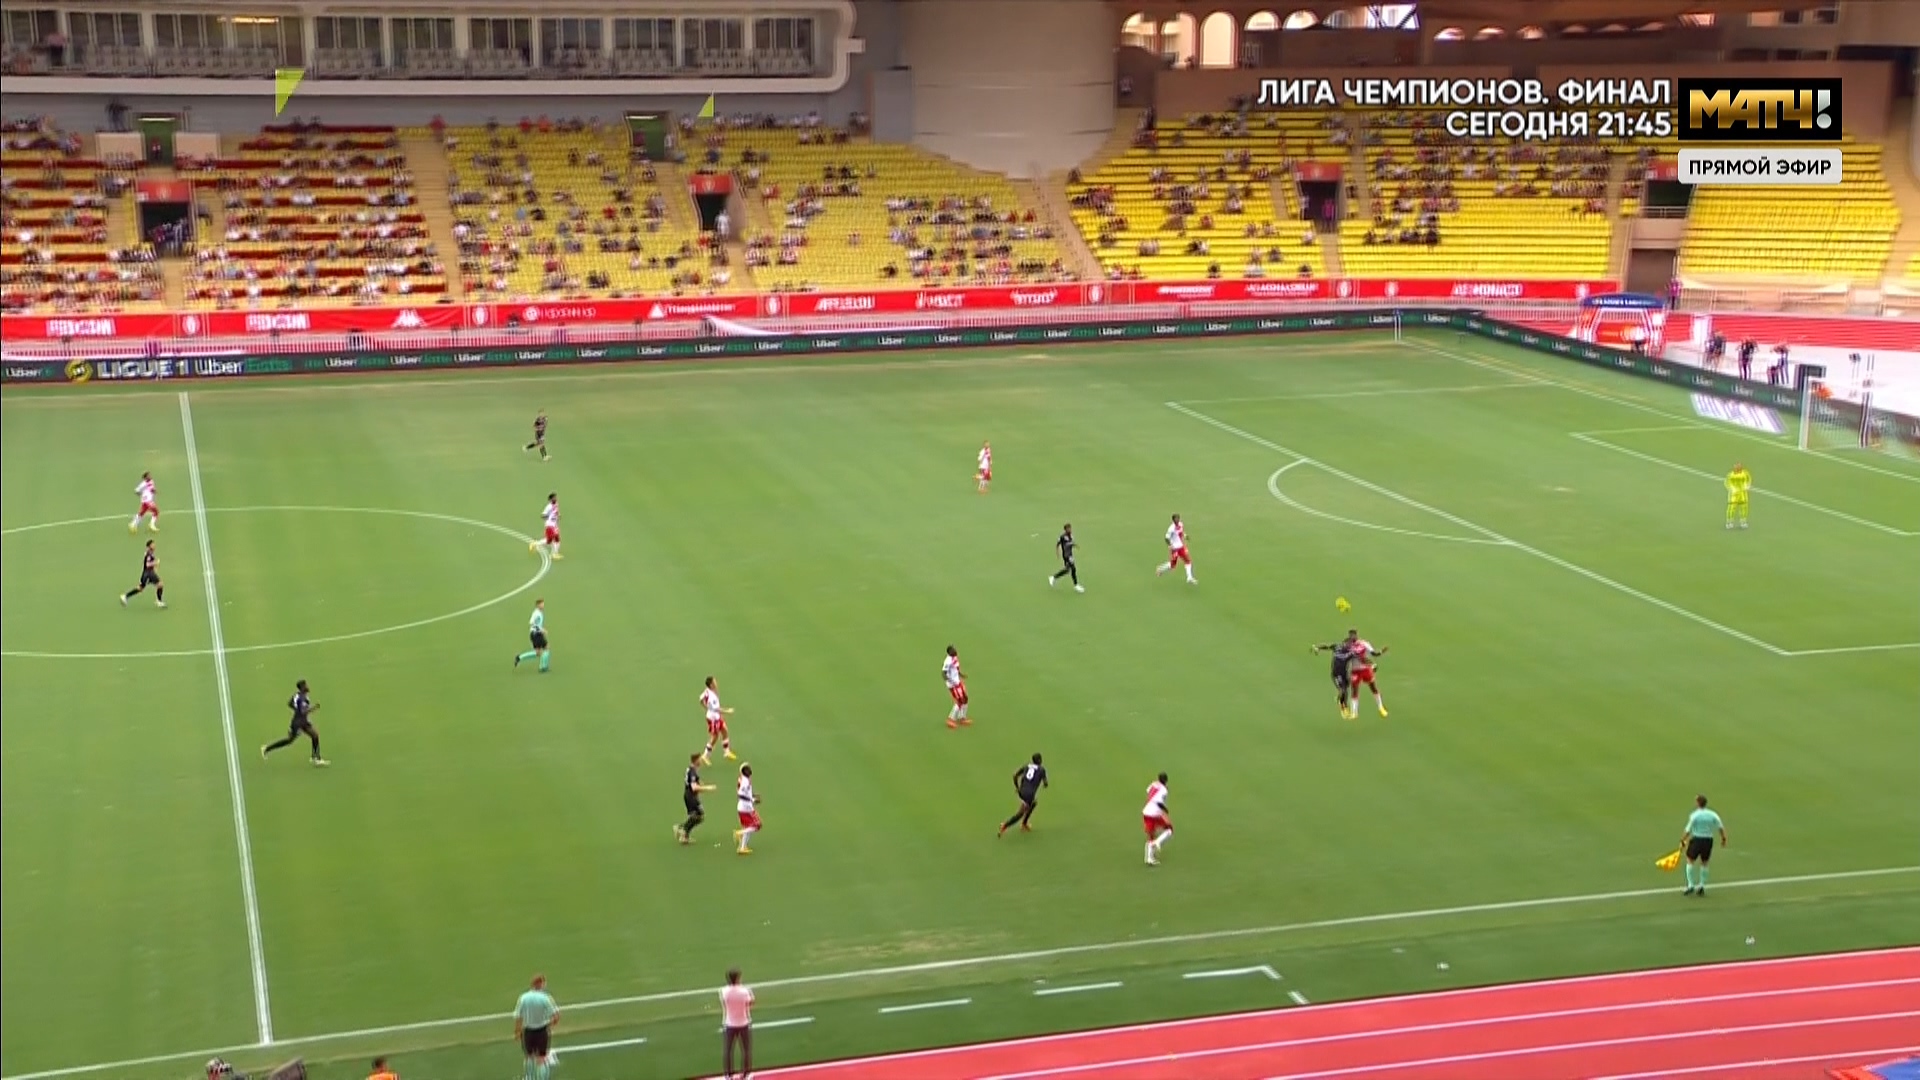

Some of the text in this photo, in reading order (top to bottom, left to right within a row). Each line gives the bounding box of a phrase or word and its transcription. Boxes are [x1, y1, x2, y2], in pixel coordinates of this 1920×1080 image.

[97, 359, 174, 378] LIGUE
[176, 360, 189, 375] 1
[194, 358, 244, 375] Uber
